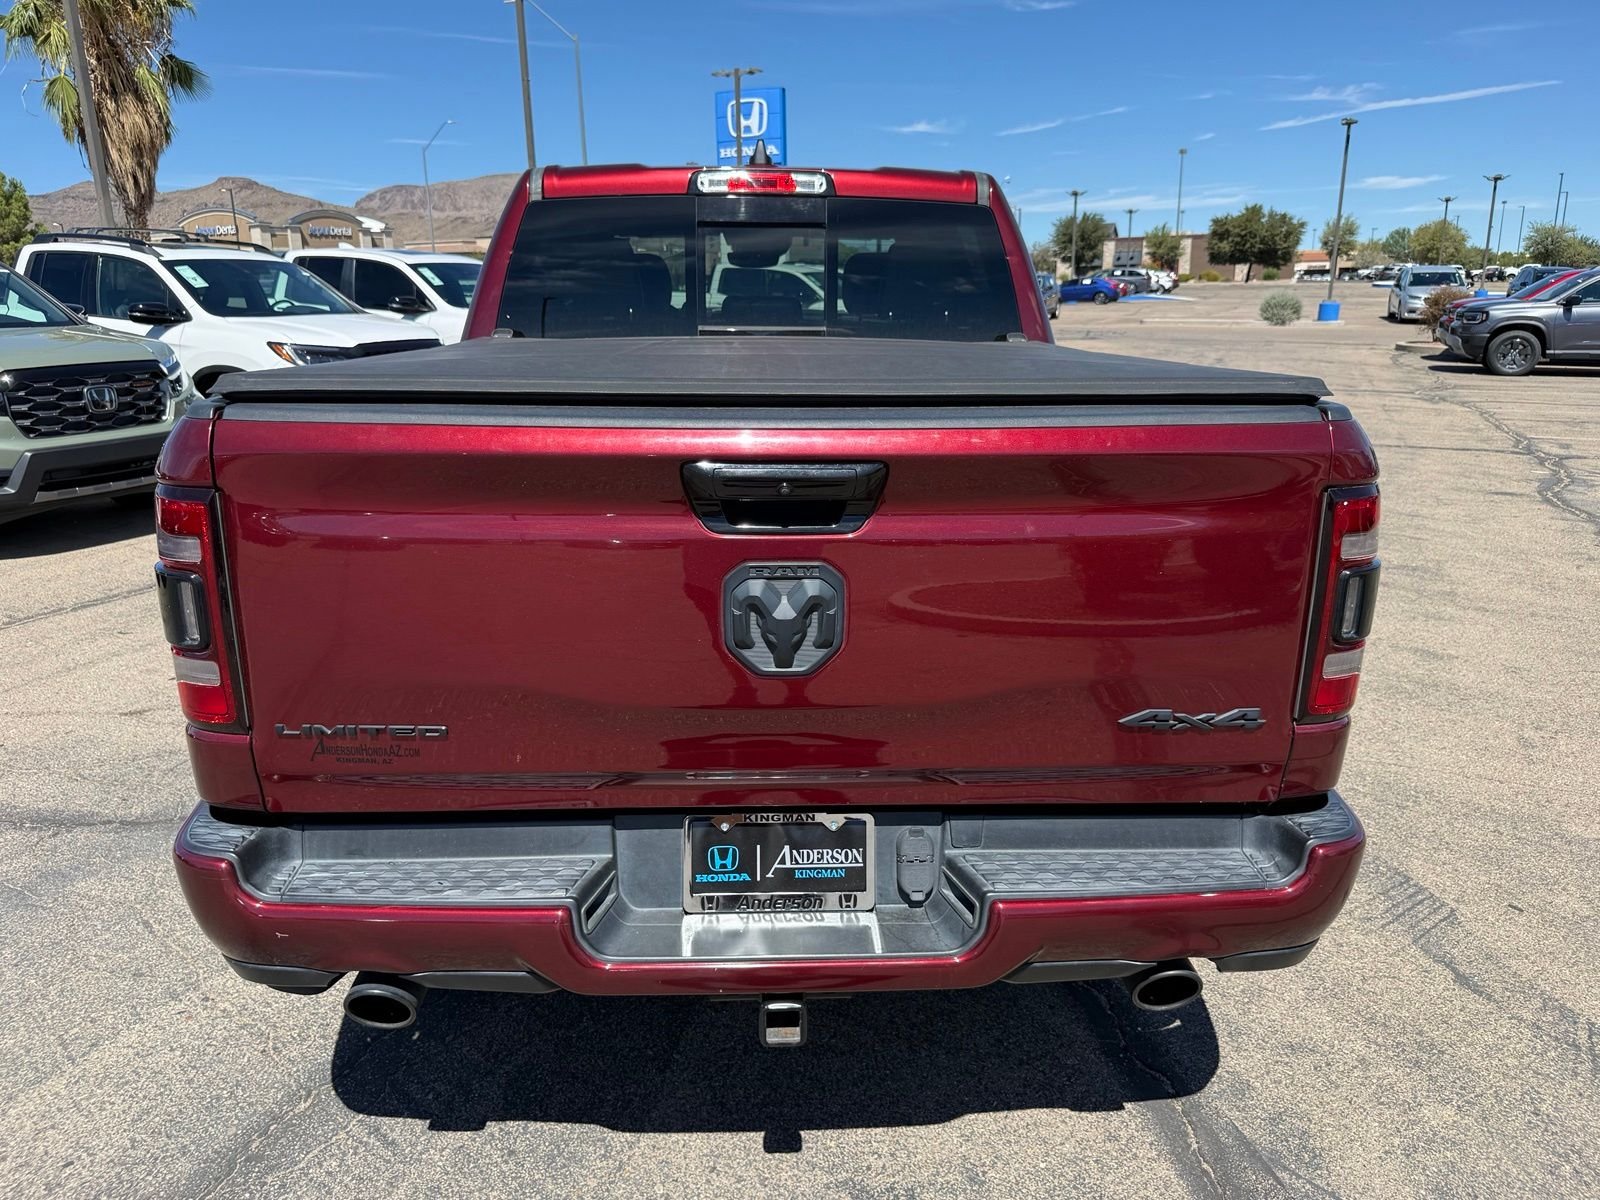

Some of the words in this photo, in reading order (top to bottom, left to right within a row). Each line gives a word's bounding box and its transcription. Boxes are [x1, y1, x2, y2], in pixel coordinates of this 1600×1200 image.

[720, 145, 779, 158] HONA
[749, 567, 820, 576] RAM
[274, 723, 449, 739] LIMITED
[743, 813, 816, 823] KINGMAN
[765, 845, 864, 878] ANDERSON
[695, 873, 751, 883] HONDA
[794, 869, 846, 879] KINGMAN
[736, 895, 825, 911] Anderson
